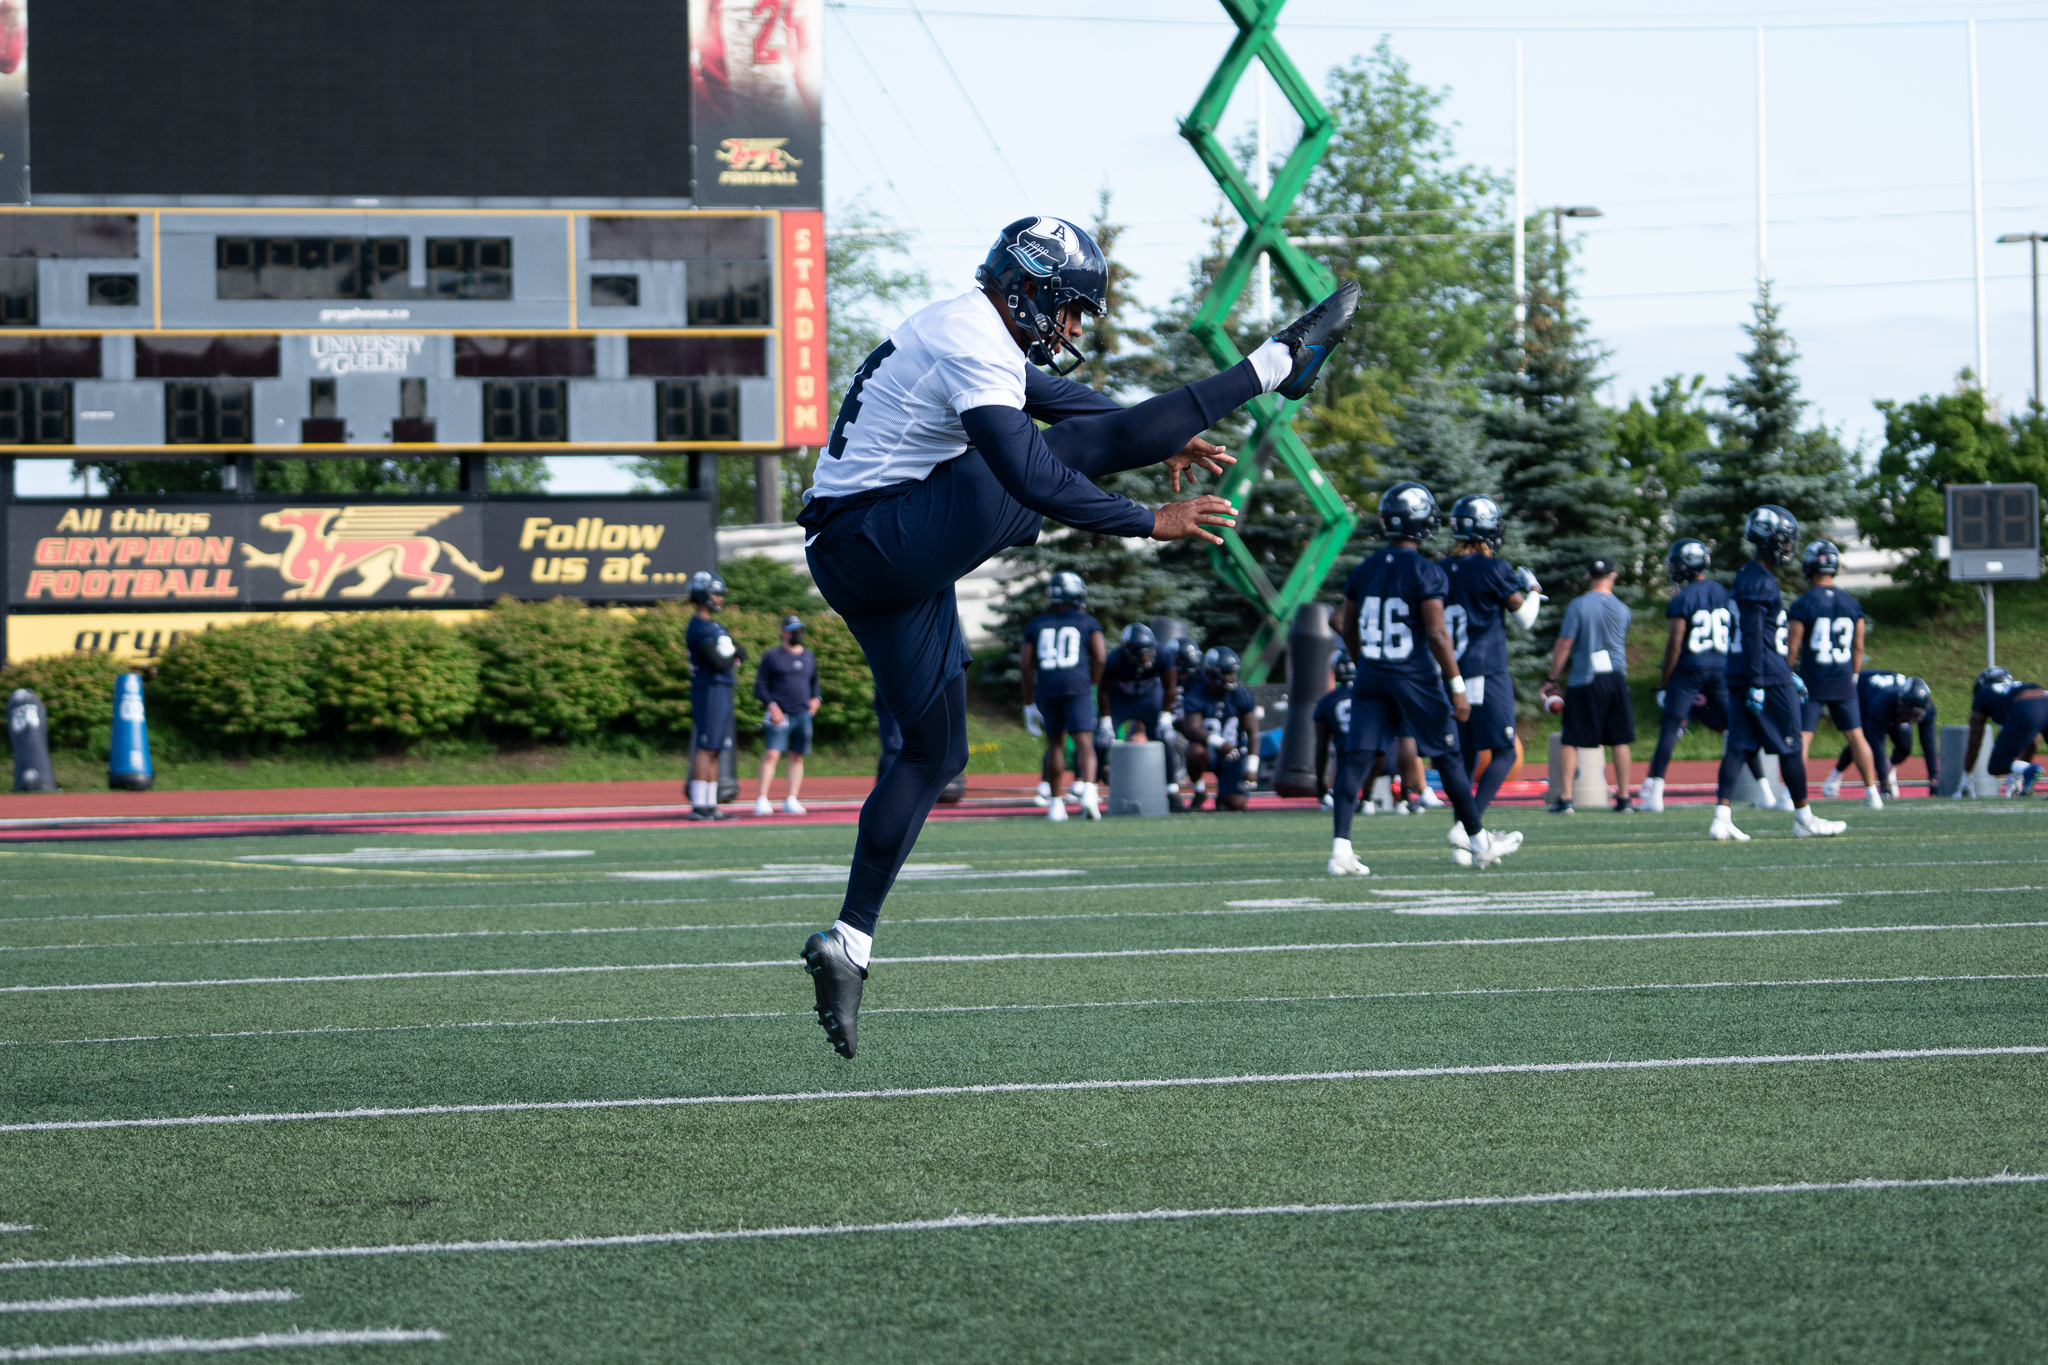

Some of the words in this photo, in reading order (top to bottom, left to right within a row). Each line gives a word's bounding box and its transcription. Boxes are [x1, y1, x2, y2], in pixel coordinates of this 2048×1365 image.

[1050, 223, 1067, 243] A
[793, 228, 818, 430] STADIUM
[310, 335, 425, 358] UNIVERSITY
[331, 352, 407, 376] GUELPH
[56, 508, 103, 533] All
[110, 508, 211, 536] things
[519, 517, 665, 551] Follow
[35, 536, 234, 566] GRYPHON
[25, 569, 239, 599] FOOTBALL
[530, 557, 589, 584] us
[1359, 596, 1414, 660] 46
[1689, 608, 1731, 654] 26
[1810, 617, 1855, 664] 43
[1037, 626, 1081, 670] 40
